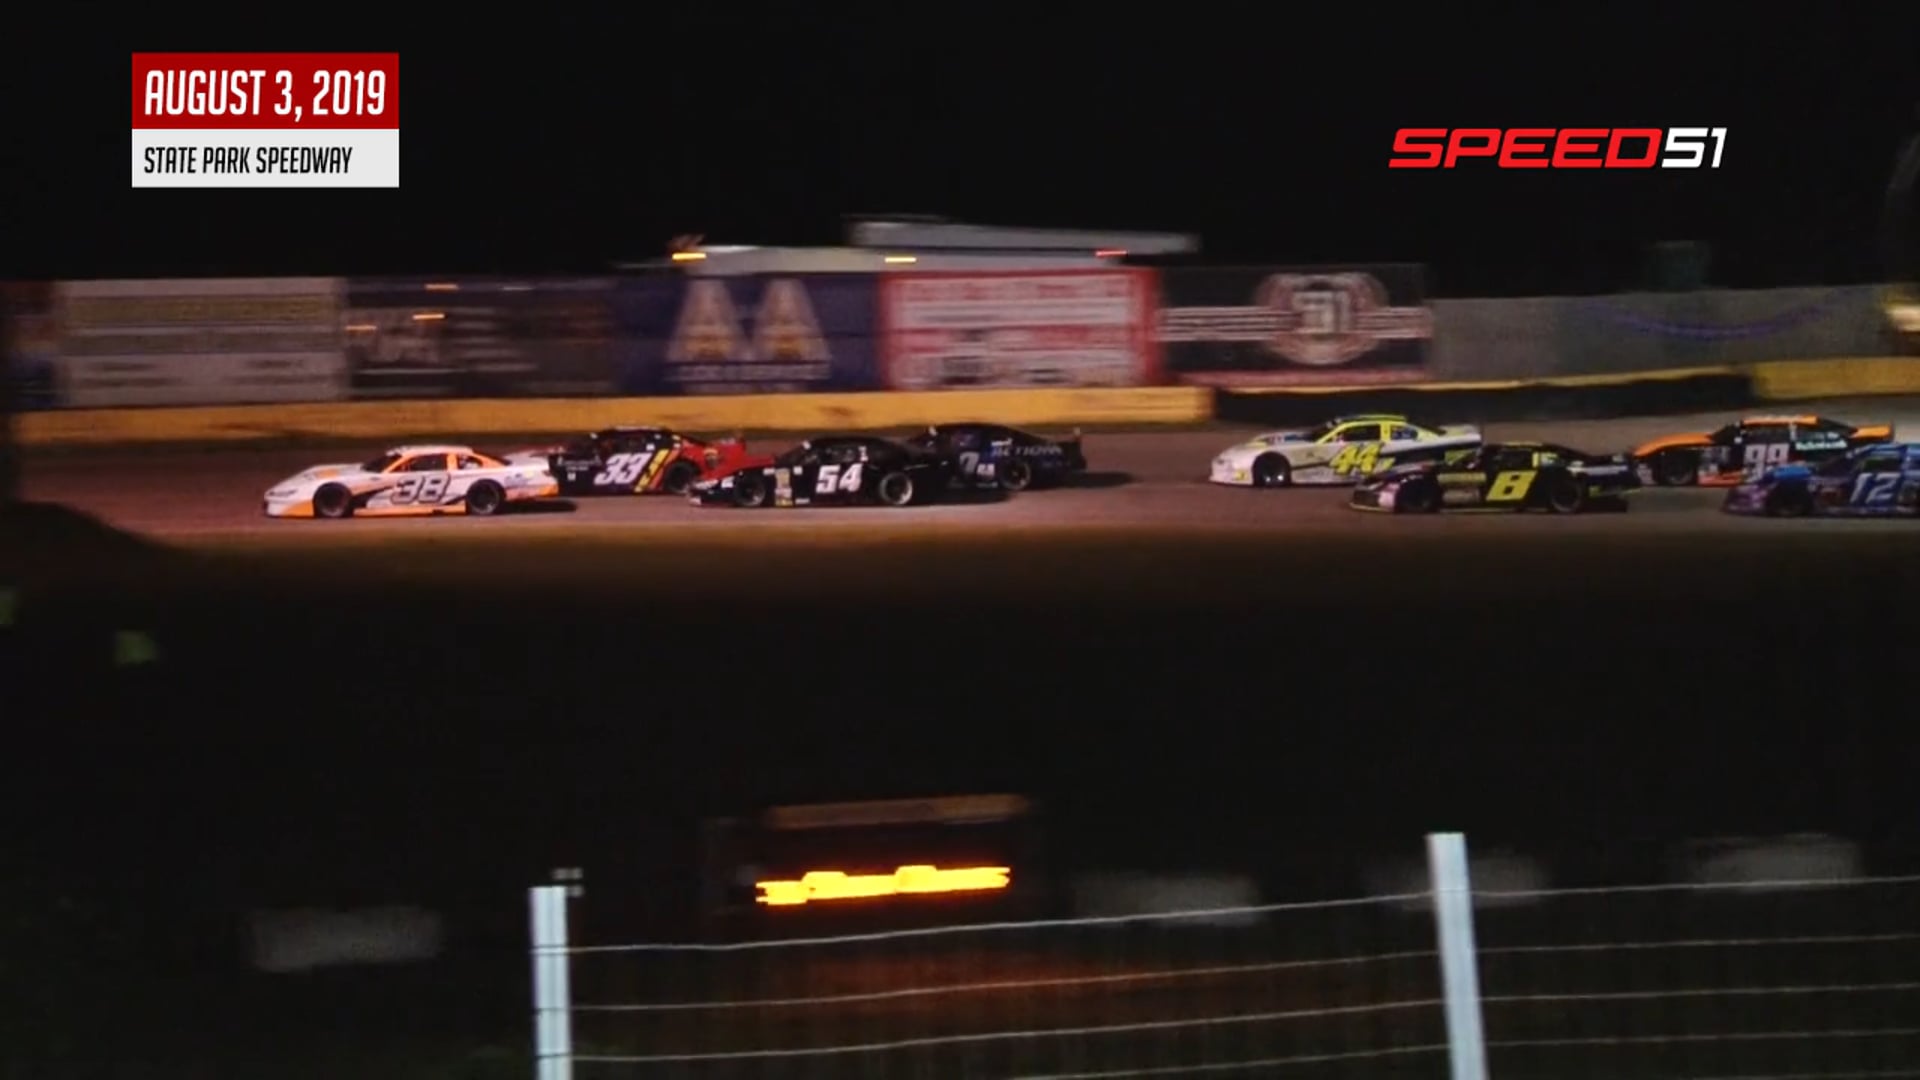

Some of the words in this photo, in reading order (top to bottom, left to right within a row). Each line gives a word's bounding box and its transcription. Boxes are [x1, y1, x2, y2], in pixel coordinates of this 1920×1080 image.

[594, 453, 652, 484] 33
[1329, 442, 1380, 475] 44
[391, 472, 450, 504] 38
[815, 463, 863, 493] 54
[1485, 471, 1537, 501] 8
[1850, 472, 1901, 504] 12
